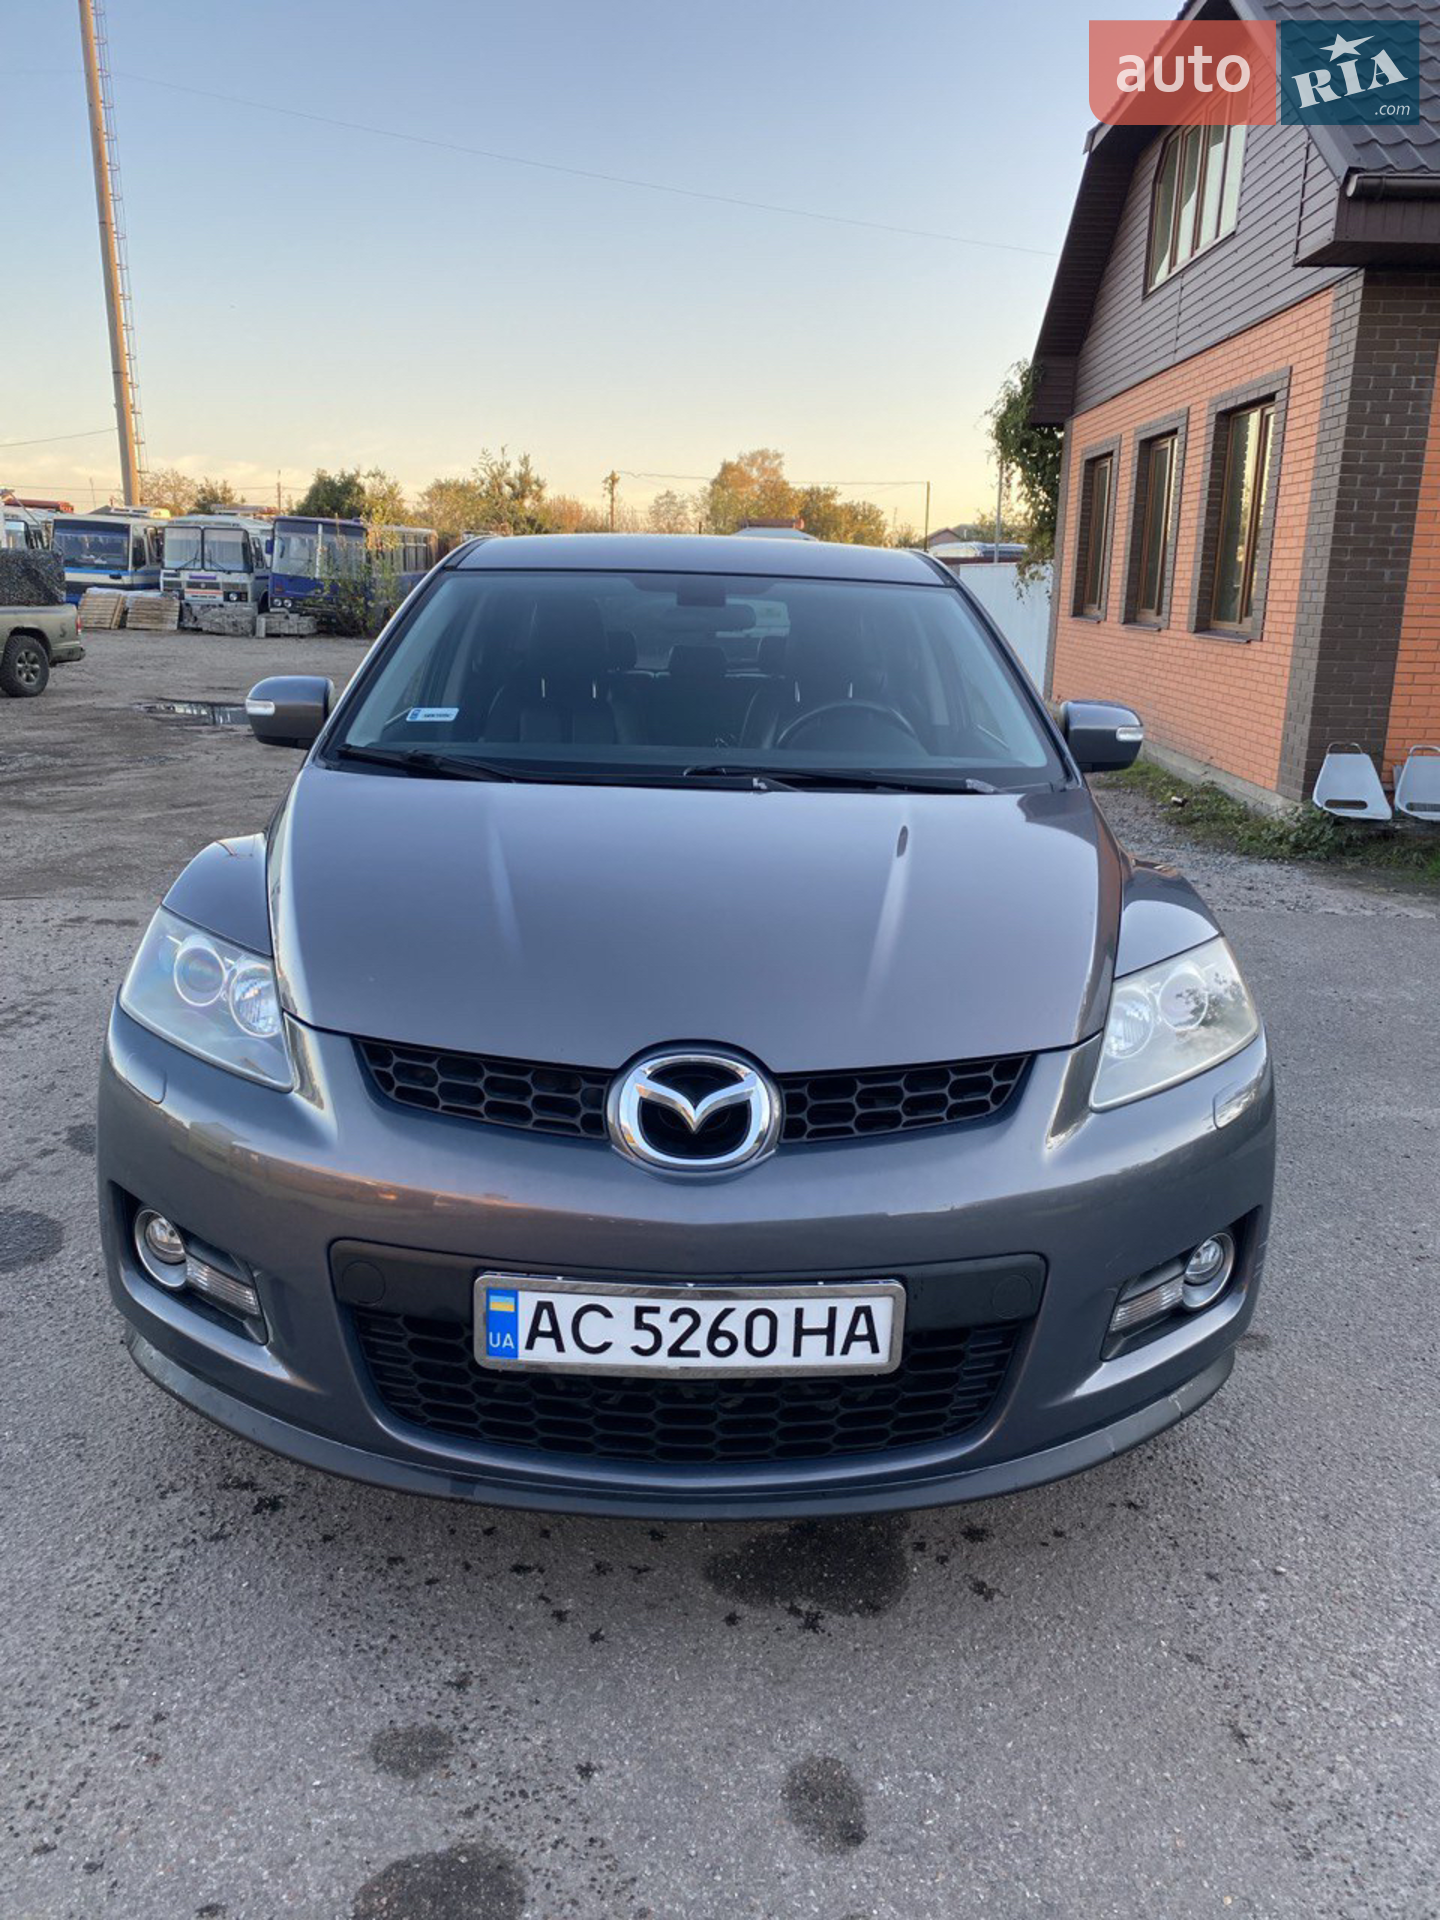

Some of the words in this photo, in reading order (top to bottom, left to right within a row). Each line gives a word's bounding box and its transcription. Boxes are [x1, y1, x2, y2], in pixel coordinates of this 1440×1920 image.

[489, 1332, 515, 1349] UA
[525, 1300, 614, 1355] AC
[630, 1306, 779, 1358] 5260
[792, 1305, 880, 1358] HA
